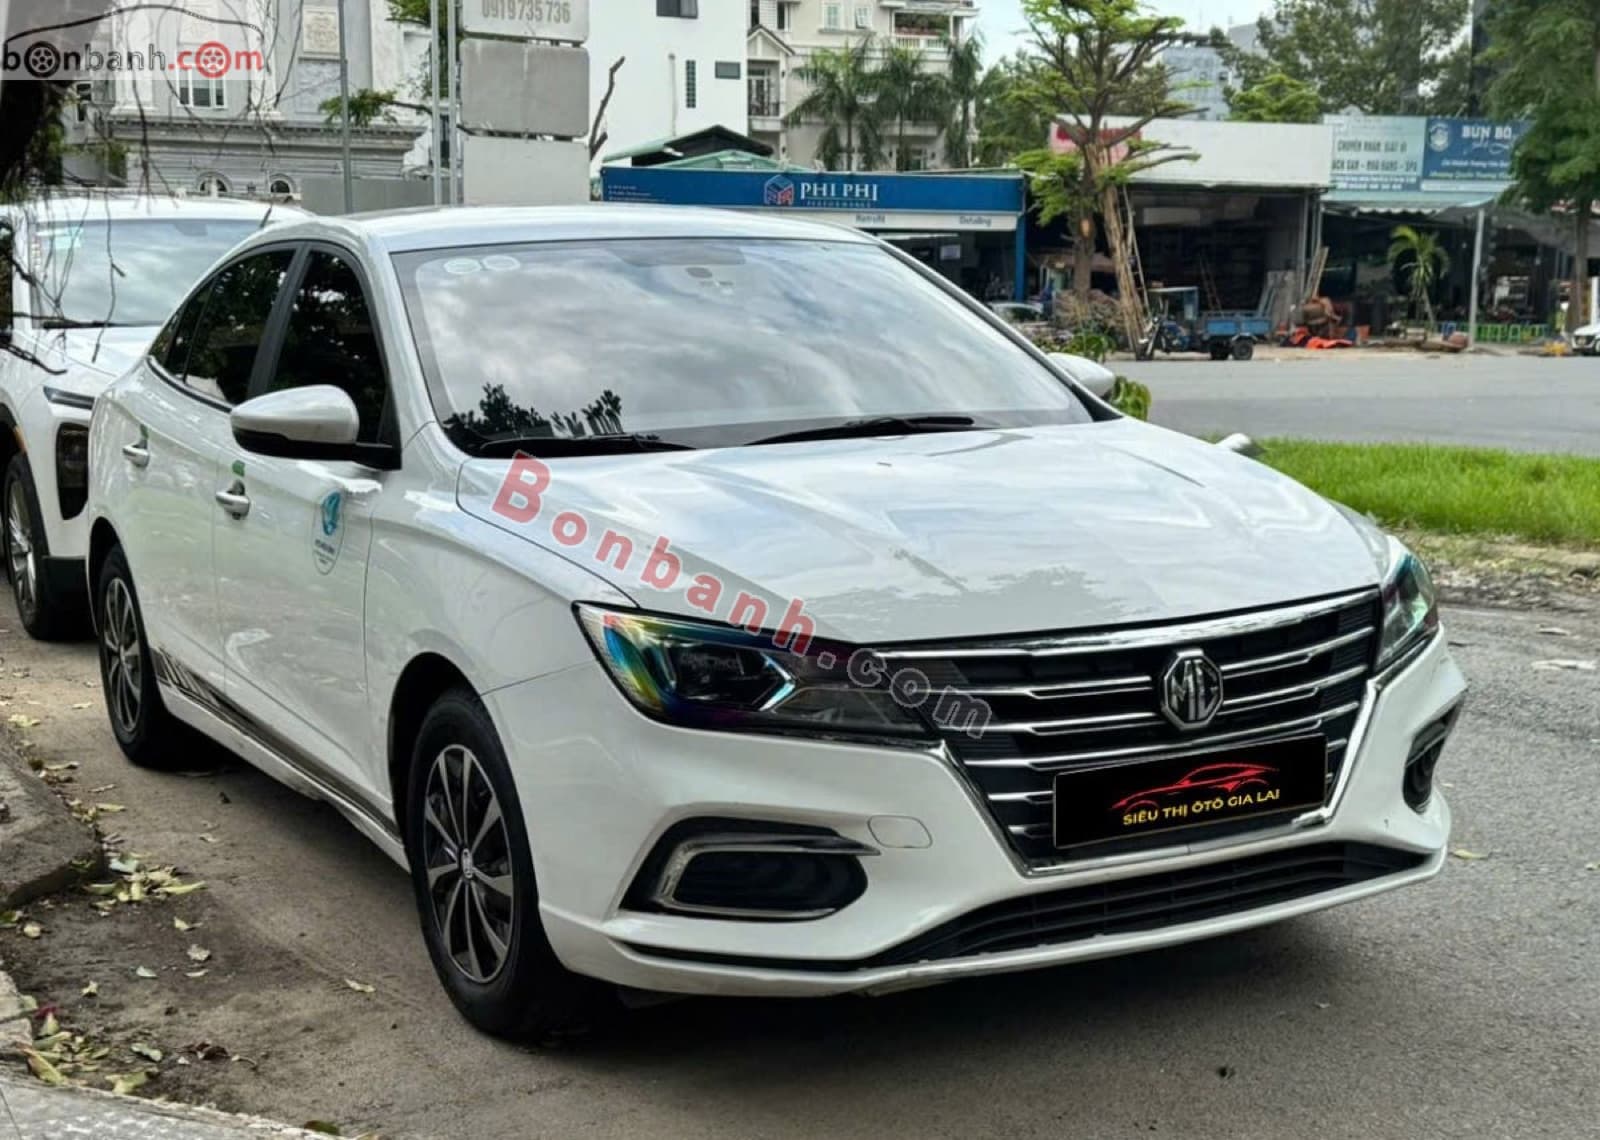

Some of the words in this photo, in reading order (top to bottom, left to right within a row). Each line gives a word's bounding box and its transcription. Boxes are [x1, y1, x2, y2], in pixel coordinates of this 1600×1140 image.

[800, 182, 837, 200] PHI
[842, 183, 878, 201] PHI
[1168, 655, 1220, 723] MG
[1123, 808, 1159, 826] SIÊU
[1162, 804, 1188, 818] THỊ
[1228, 793, 1253, 807] GIA
[1257, 788, 1280, 802] LAI
